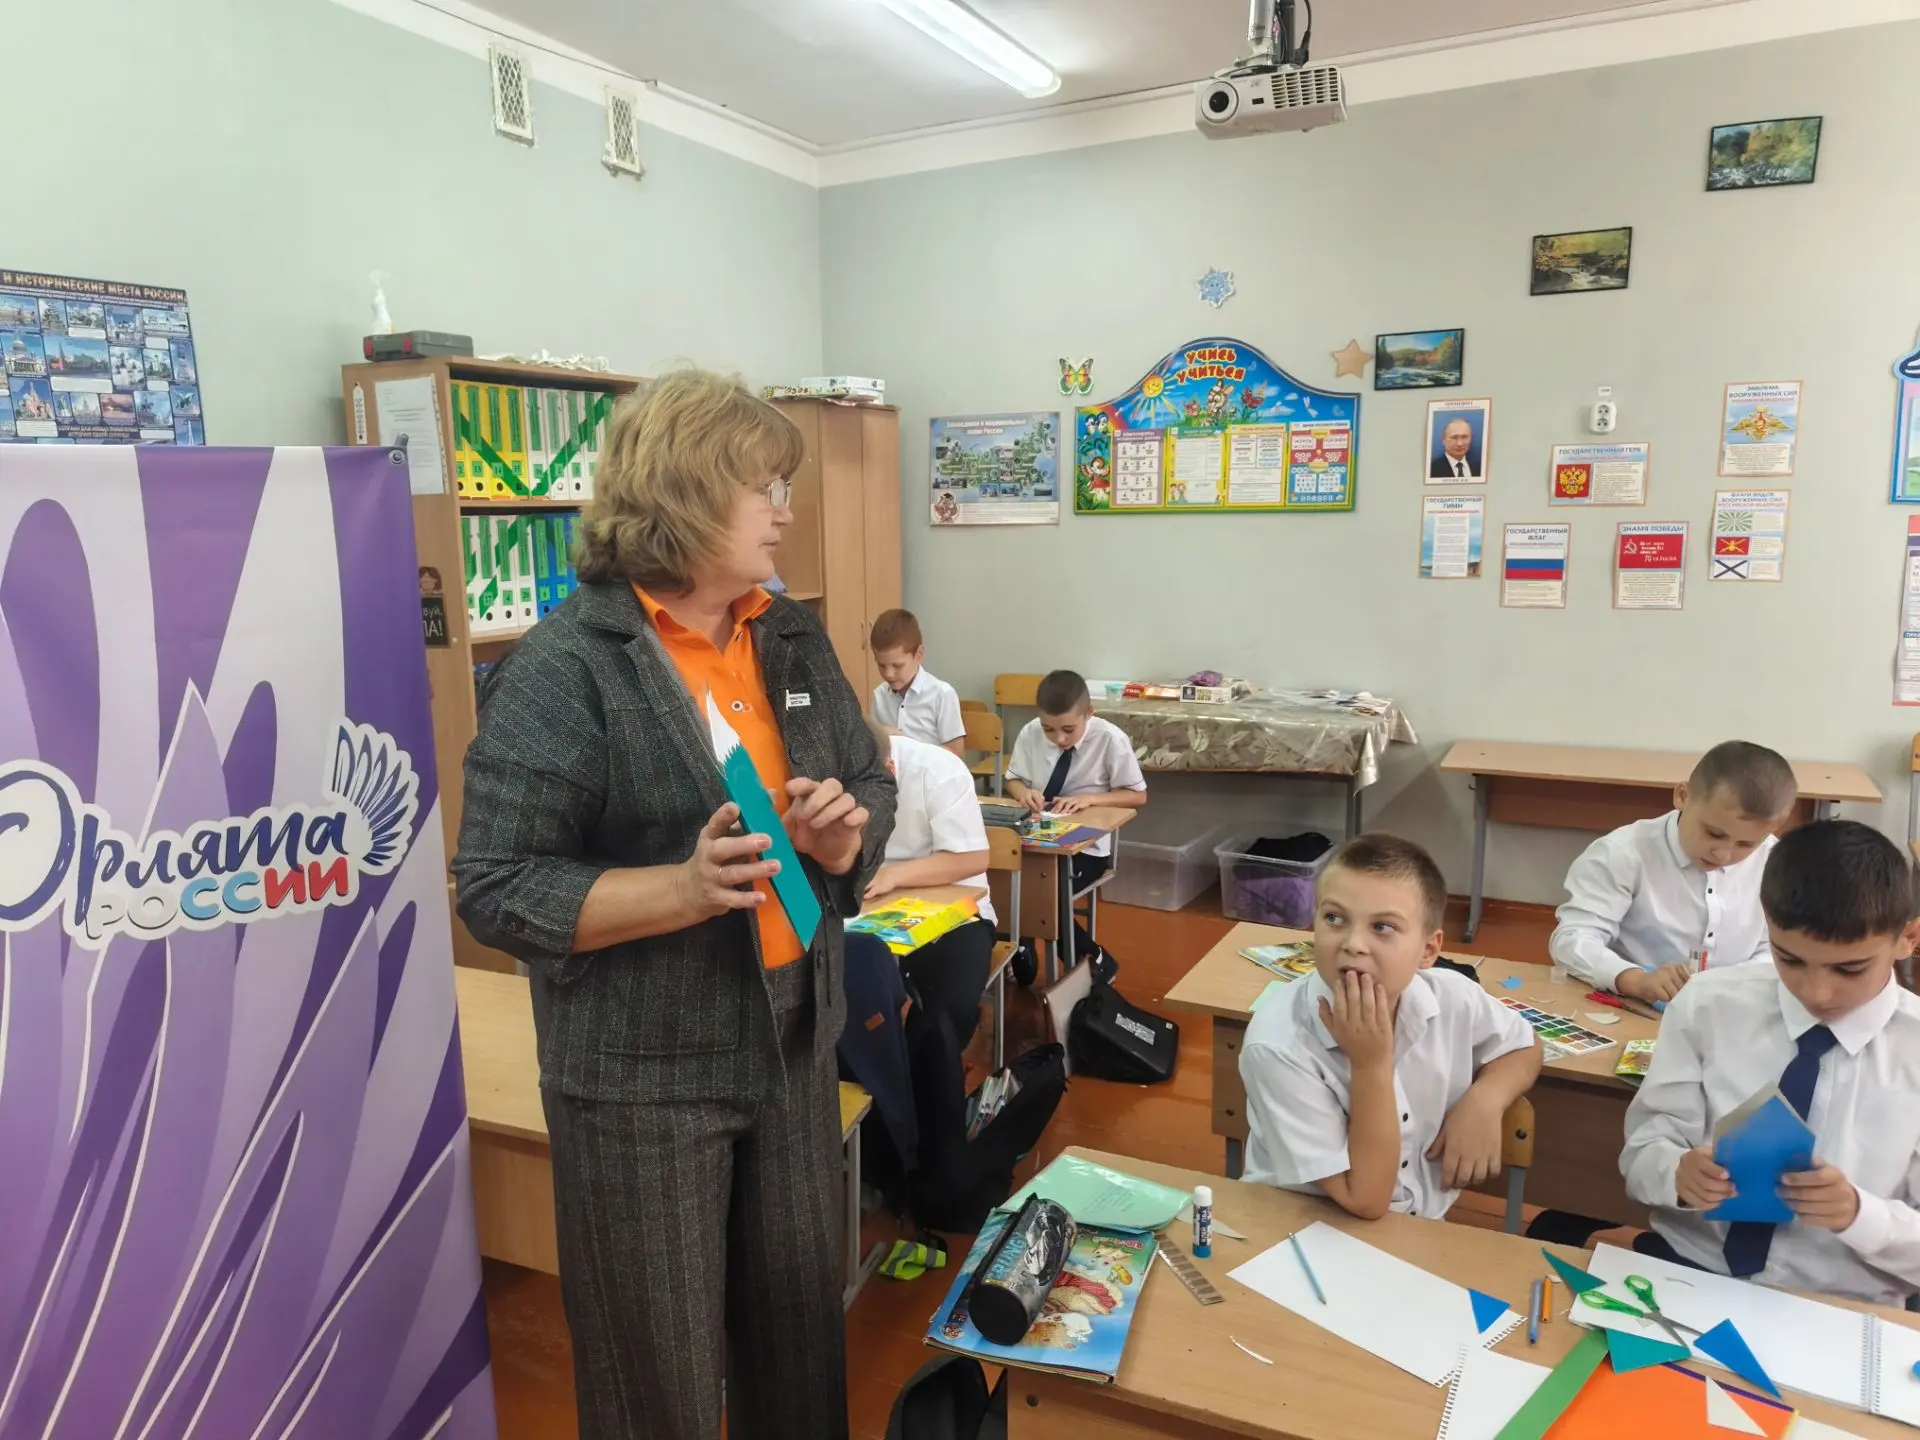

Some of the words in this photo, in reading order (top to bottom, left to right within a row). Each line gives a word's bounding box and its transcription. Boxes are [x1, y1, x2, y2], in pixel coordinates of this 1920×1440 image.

[3, 272, 12, 284] И
[16, 273, 105, 294] ИСТОРИЧЕСКИЕ
[108, 284, 142, 298] МЕСТА
[144, 289, 185, 302] РОССИИ
[1185, 348, 1236, 365] УЧИСЬ
[1175, 365, 1246, 385] УЧИТЬСЯ
[0, 770, 349, 926] Орлята
